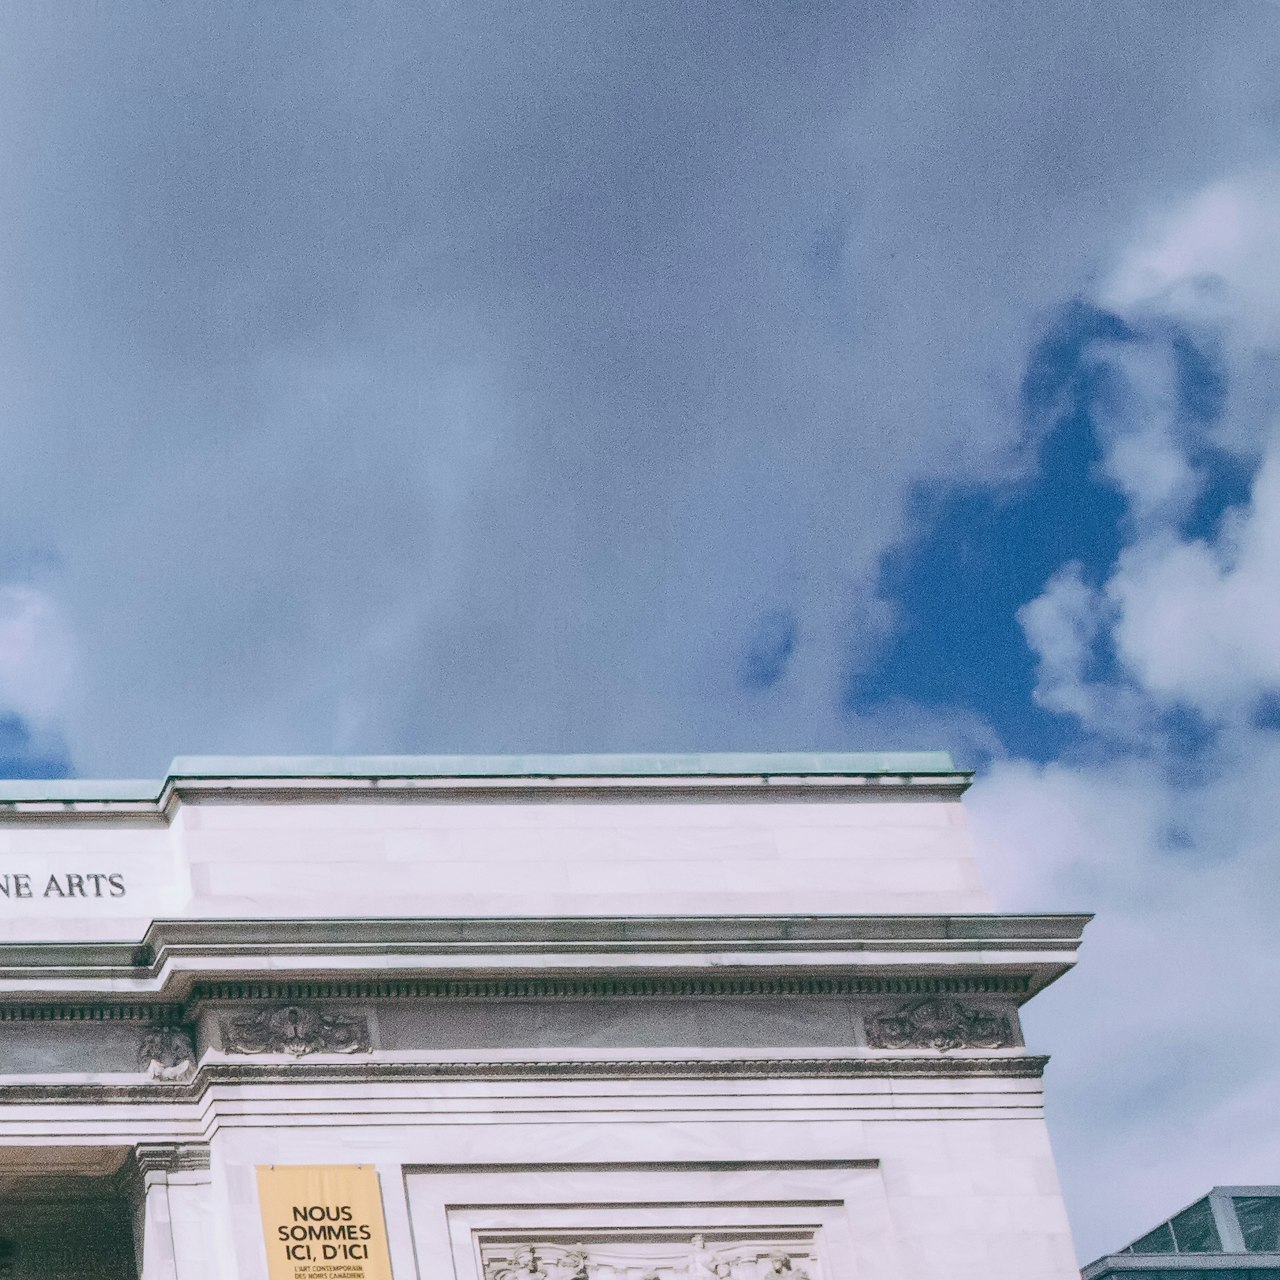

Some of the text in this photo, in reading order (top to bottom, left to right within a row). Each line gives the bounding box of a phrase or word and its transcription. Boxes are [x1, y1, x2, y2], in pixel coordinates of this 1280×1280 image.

[43, 873, 126, 898] ARTS
[292, 1206, 353, 1222] NOUS
[278, 1225, 371, 1241] SOMMES
[286, 1244, 369, 1262] ICI, D'ICI
